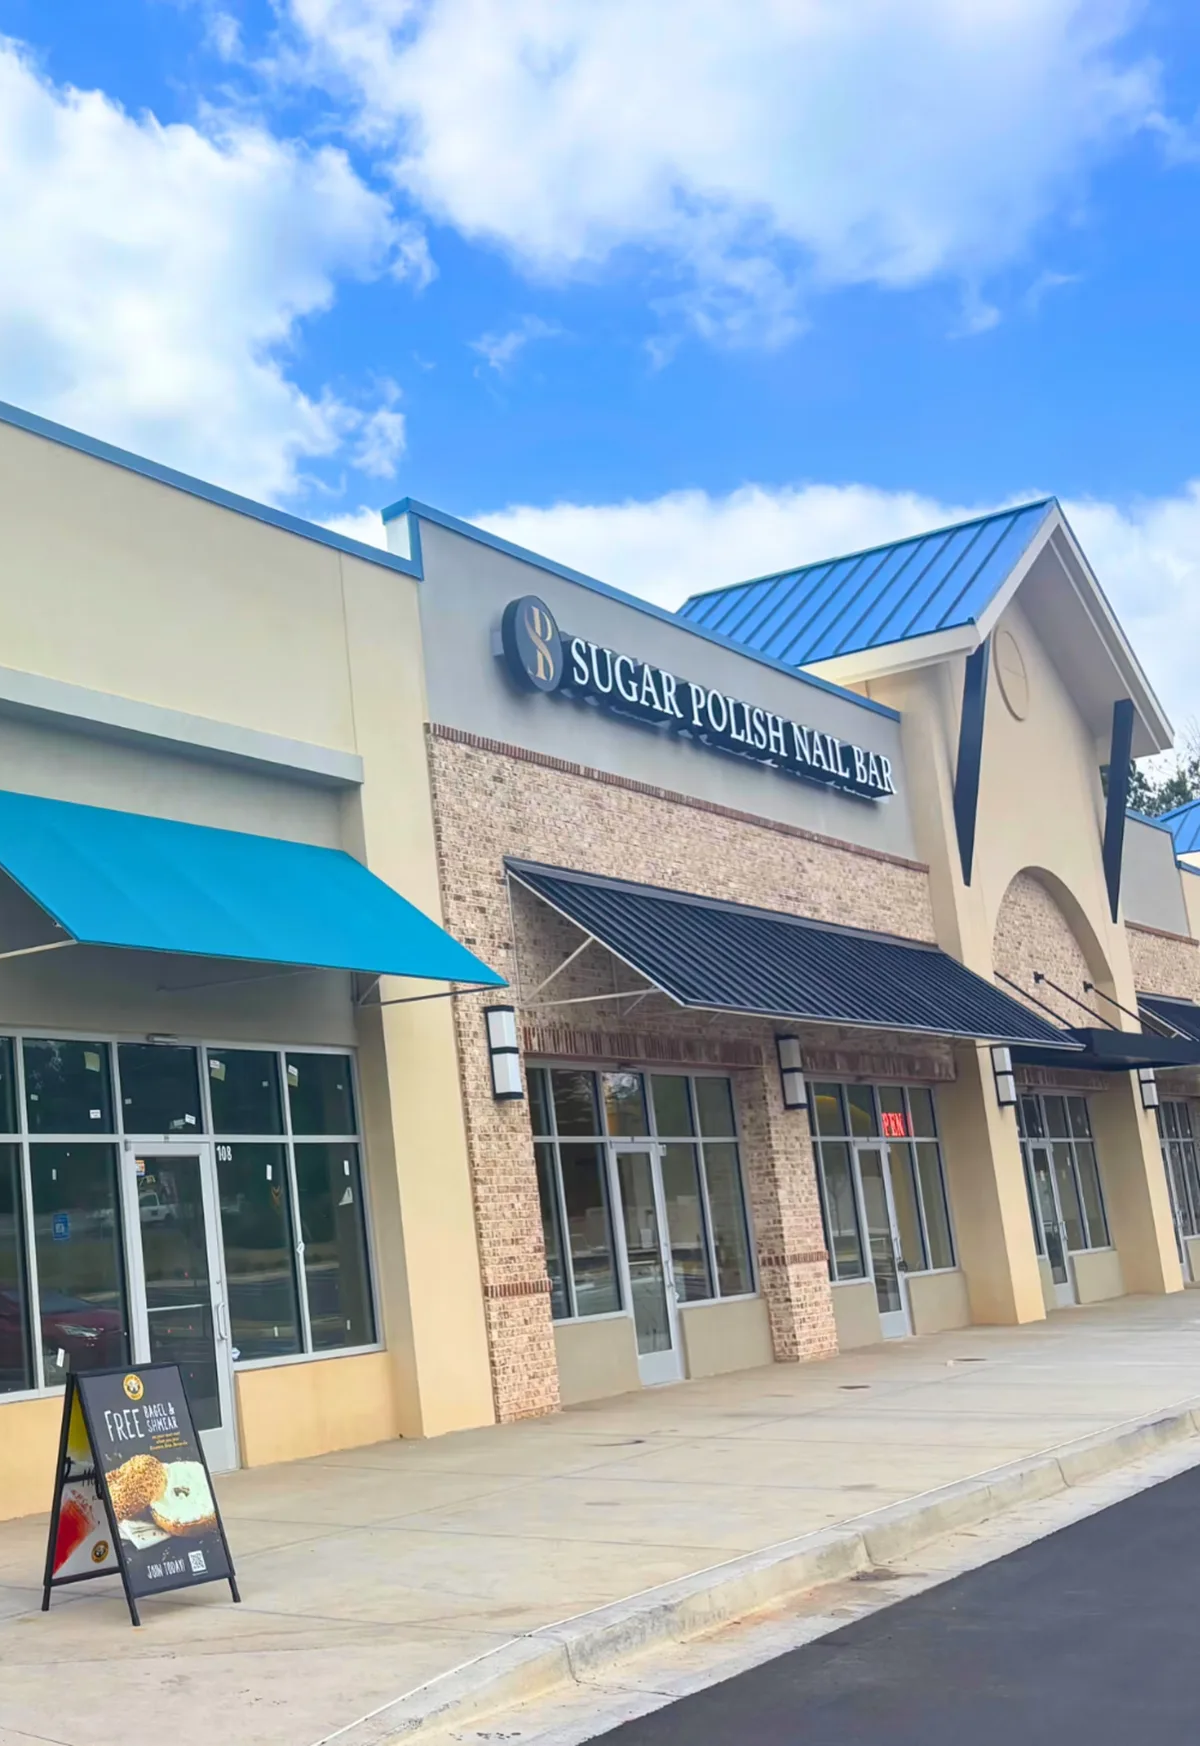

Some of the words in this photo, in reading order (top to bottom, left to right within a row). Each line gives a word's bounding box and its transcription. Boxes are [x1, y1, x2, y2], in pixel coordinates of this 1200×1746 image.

[570, 636, 684, 720] SUGAR
[688, 681, 788, 758] POLISH
[790, 721, 851, 779] NAIL
[852, 745, 897, 795] BAR
[216, 1145, 232, 1161] 108
[103, 1408, 145, 1442] FREE
[142, 1403, 167, 1419] BAGEL
[146, 1416, 179, 1433] SHMEAR
